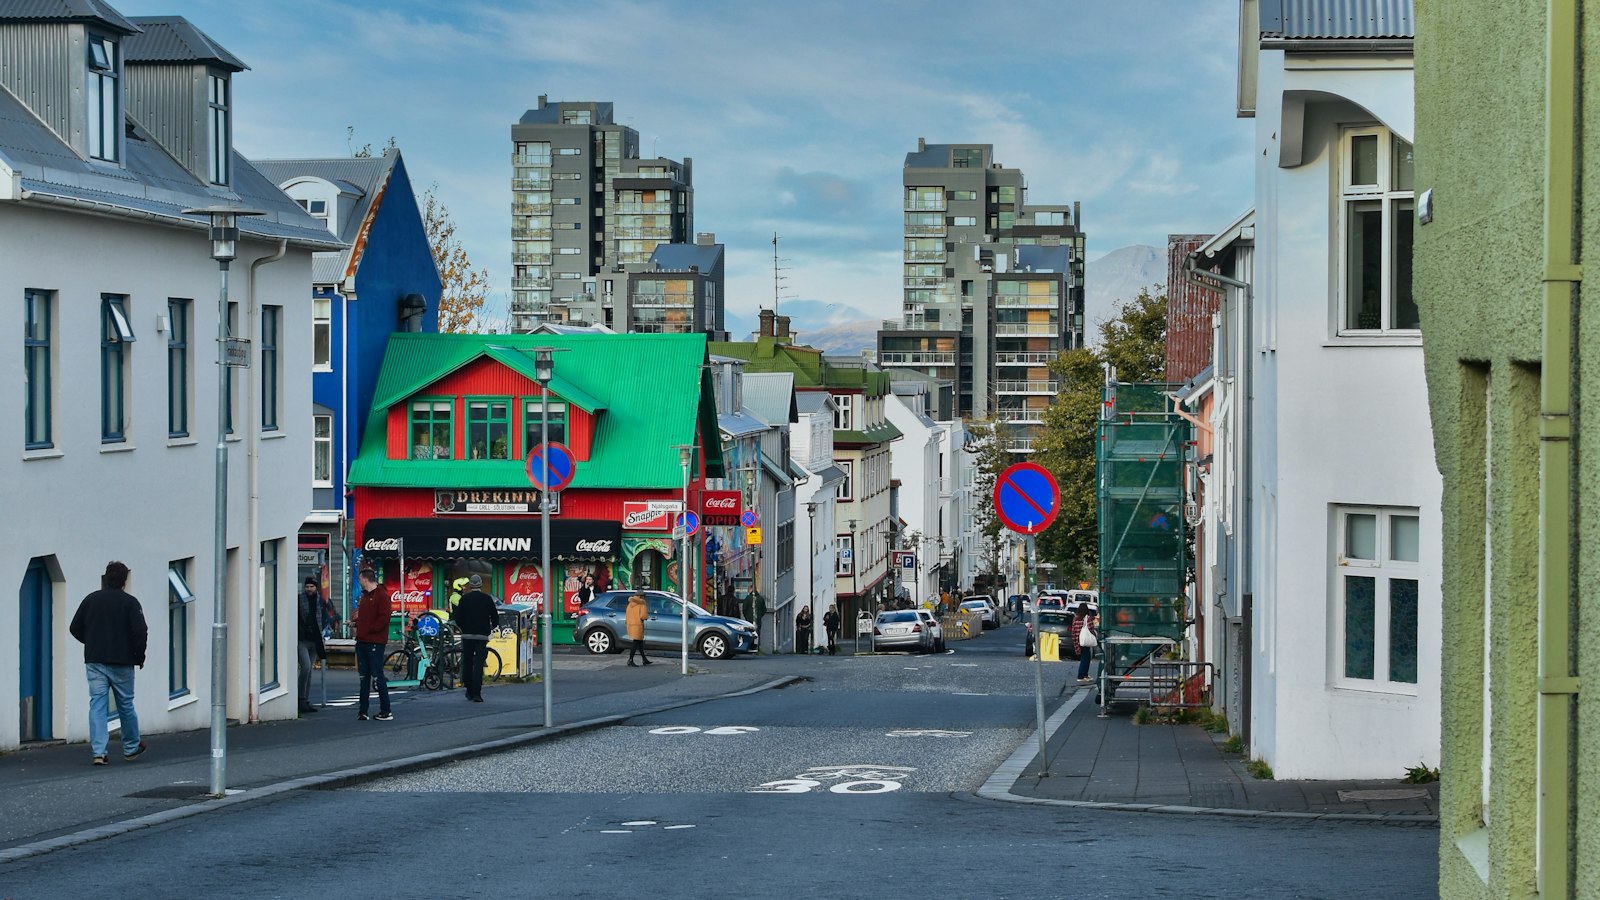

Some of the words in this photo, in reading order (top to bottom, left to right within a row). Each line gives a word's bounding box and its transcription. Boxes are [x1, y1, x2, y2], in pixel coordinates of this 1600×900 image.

[457, 491, 537, 502] DREKINN
[706, 498, 737, 508] Coca-Cola
[446, 538, 531, 551] DREKINN
[576, 539, 613, 552] Coca-Cola
[905, 557, 912, 566] P
